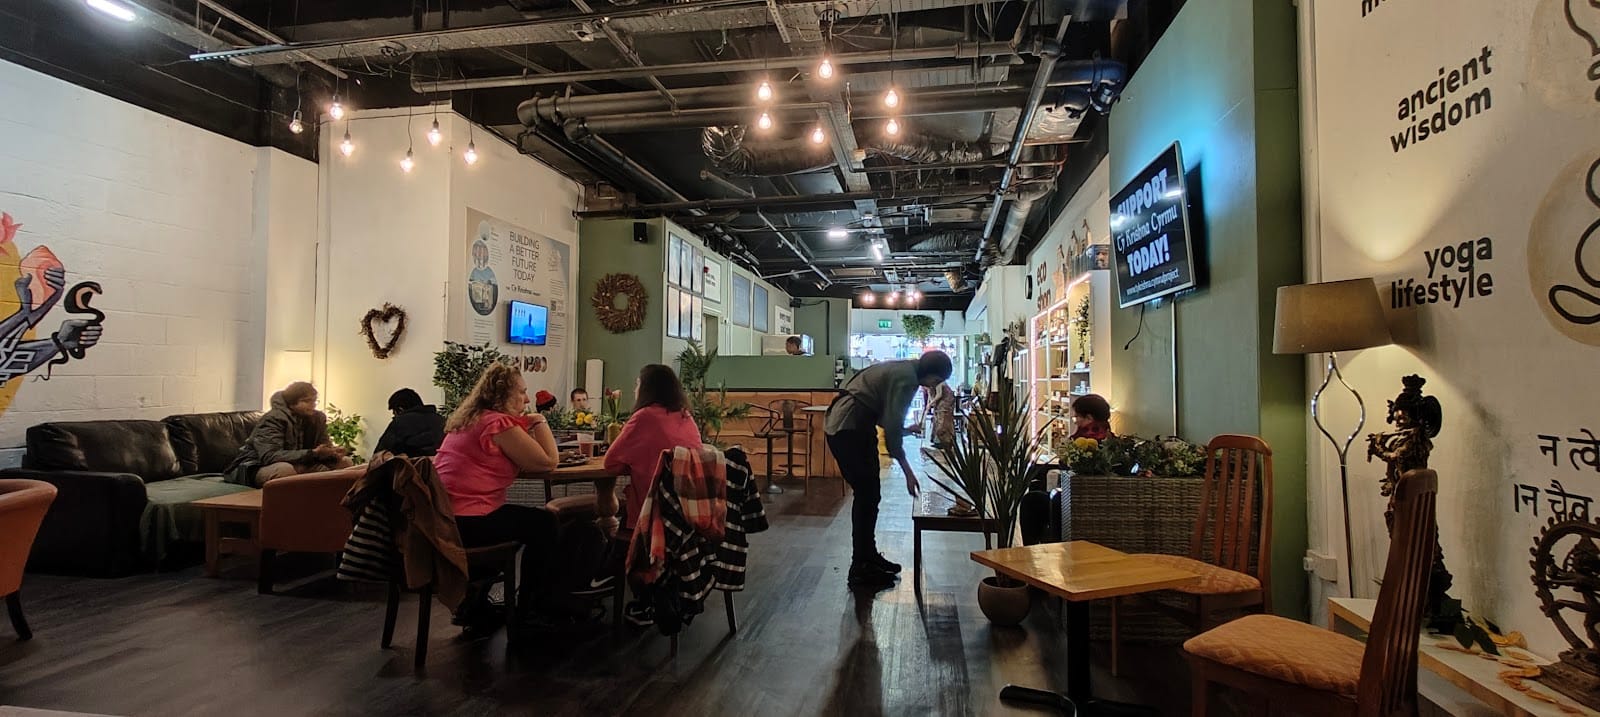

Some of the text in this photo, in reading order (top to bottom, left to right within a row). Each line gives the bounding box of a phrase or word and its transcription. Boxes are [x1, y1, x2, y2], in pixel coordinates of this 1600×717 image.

[1397, 45, 1492, 121] ancient
[1390, 87, 1491, 152] wisdom
[1117, 168, 1168, 219] SUPPORT
[509, 231, 540, 250] BUILDING
[1126, 222, 1150, 247] Krishna
[509, 244, 515, 254] A
[516, 247, 540, 260] BETTER
[511, 256, 537, 273] FUTURE
[1127, 234, 1170, 277] TODAY!
[1424, 237, 1492, 279] yoga
[513, 268, 536, 281] TODAY
[1037, 261, 1047, 287] eco
[1391, 267, 1493, 309] lifestyle
